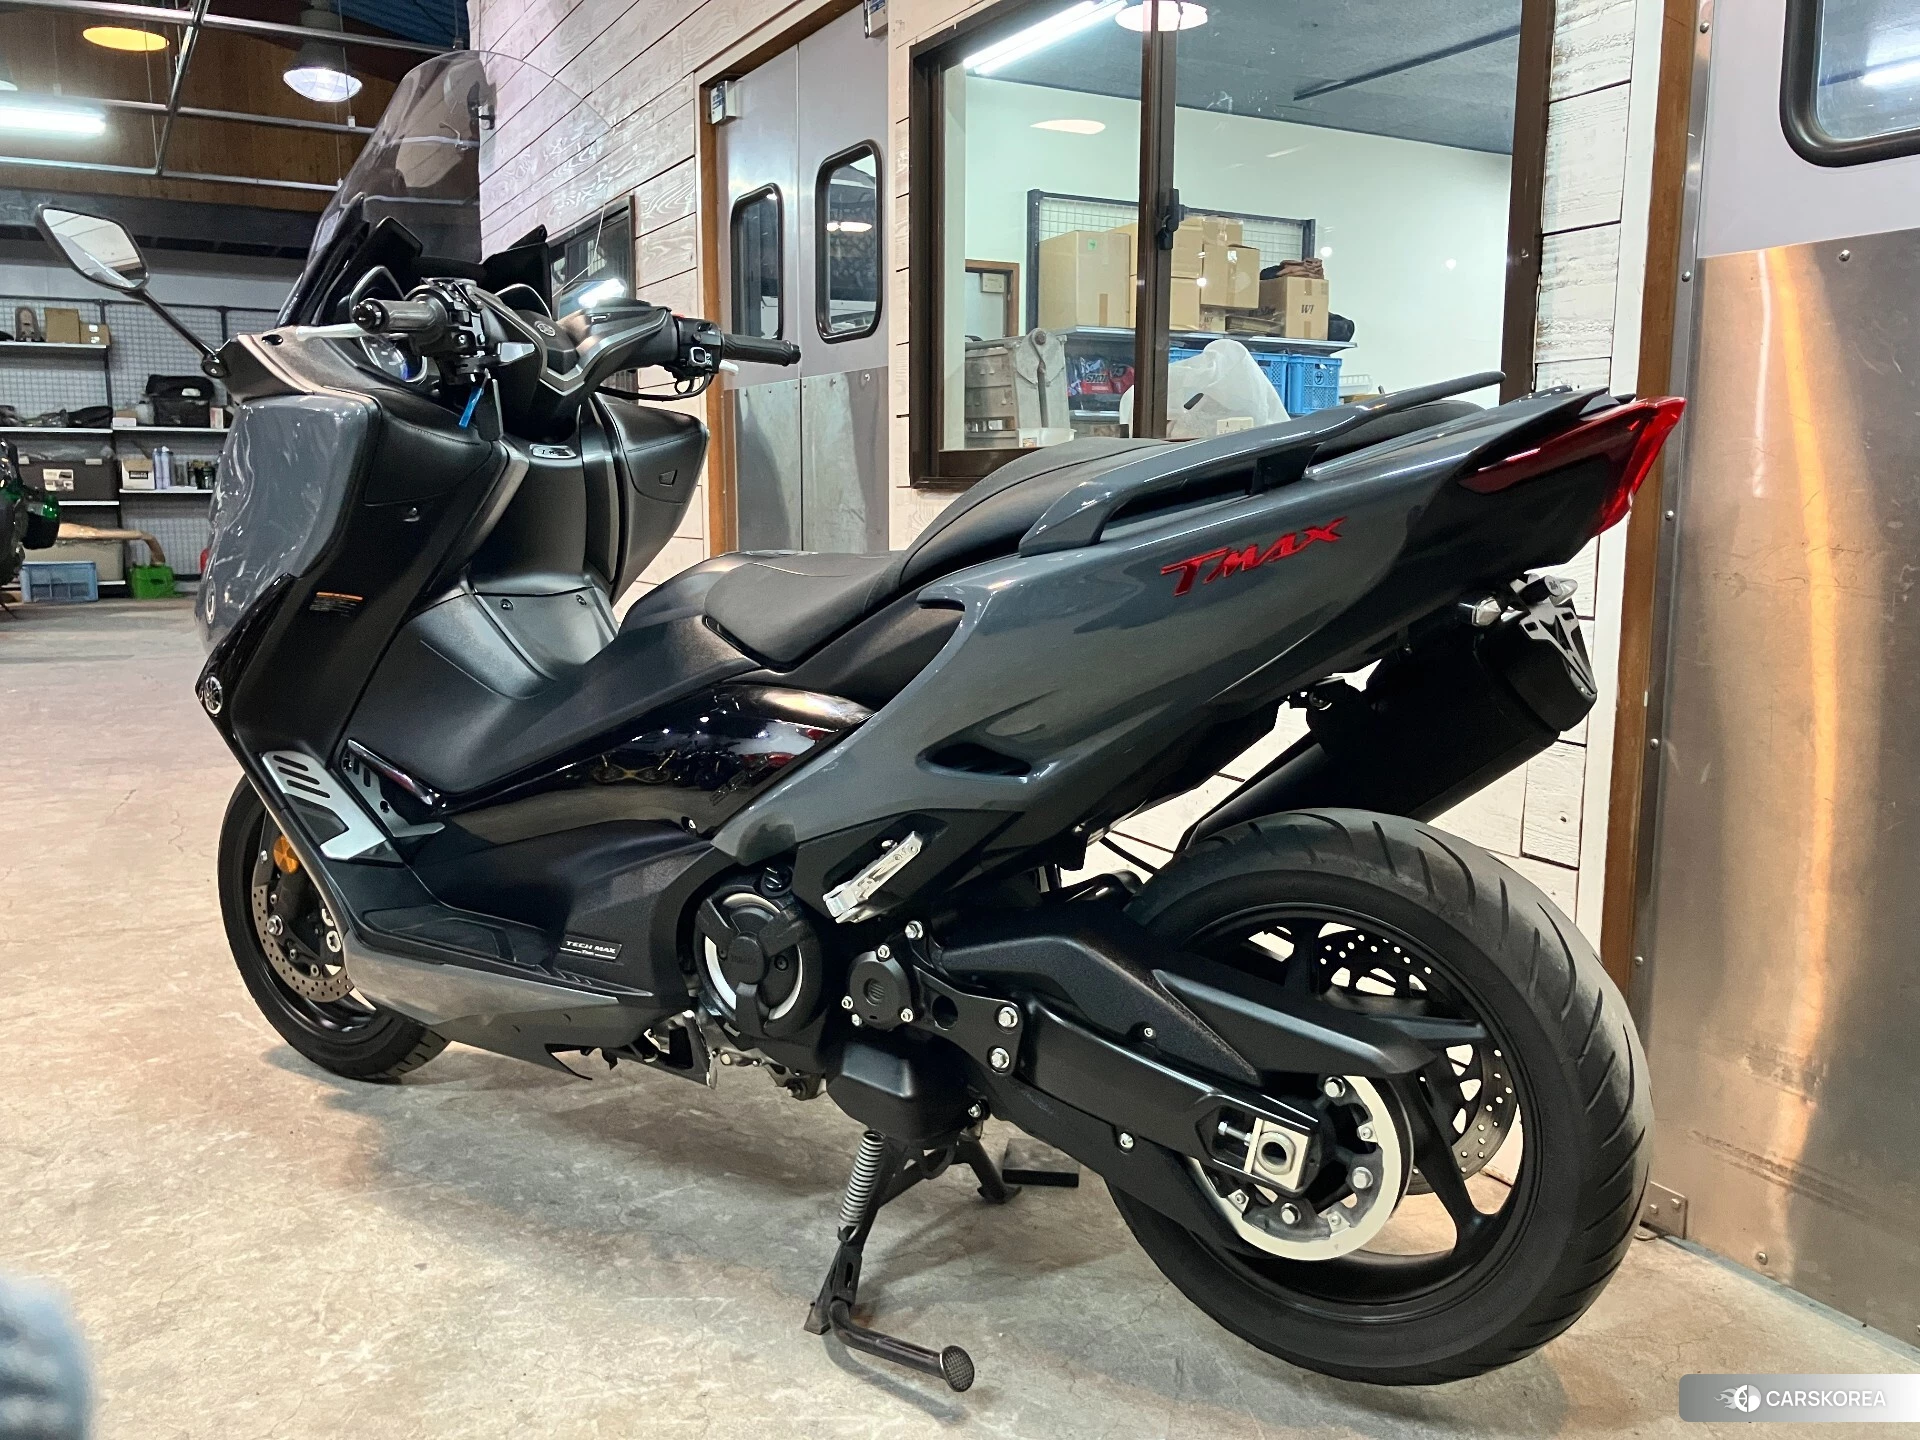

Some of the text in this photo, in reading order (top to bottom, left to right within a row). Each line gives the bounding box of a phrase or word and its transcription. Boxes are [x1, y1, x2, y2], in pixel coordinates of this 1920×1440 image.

[1160, 516, 1347, 597] TMAX
[566, 940, 593, 950] TECH
[594, 945, 616, 954] MAX
